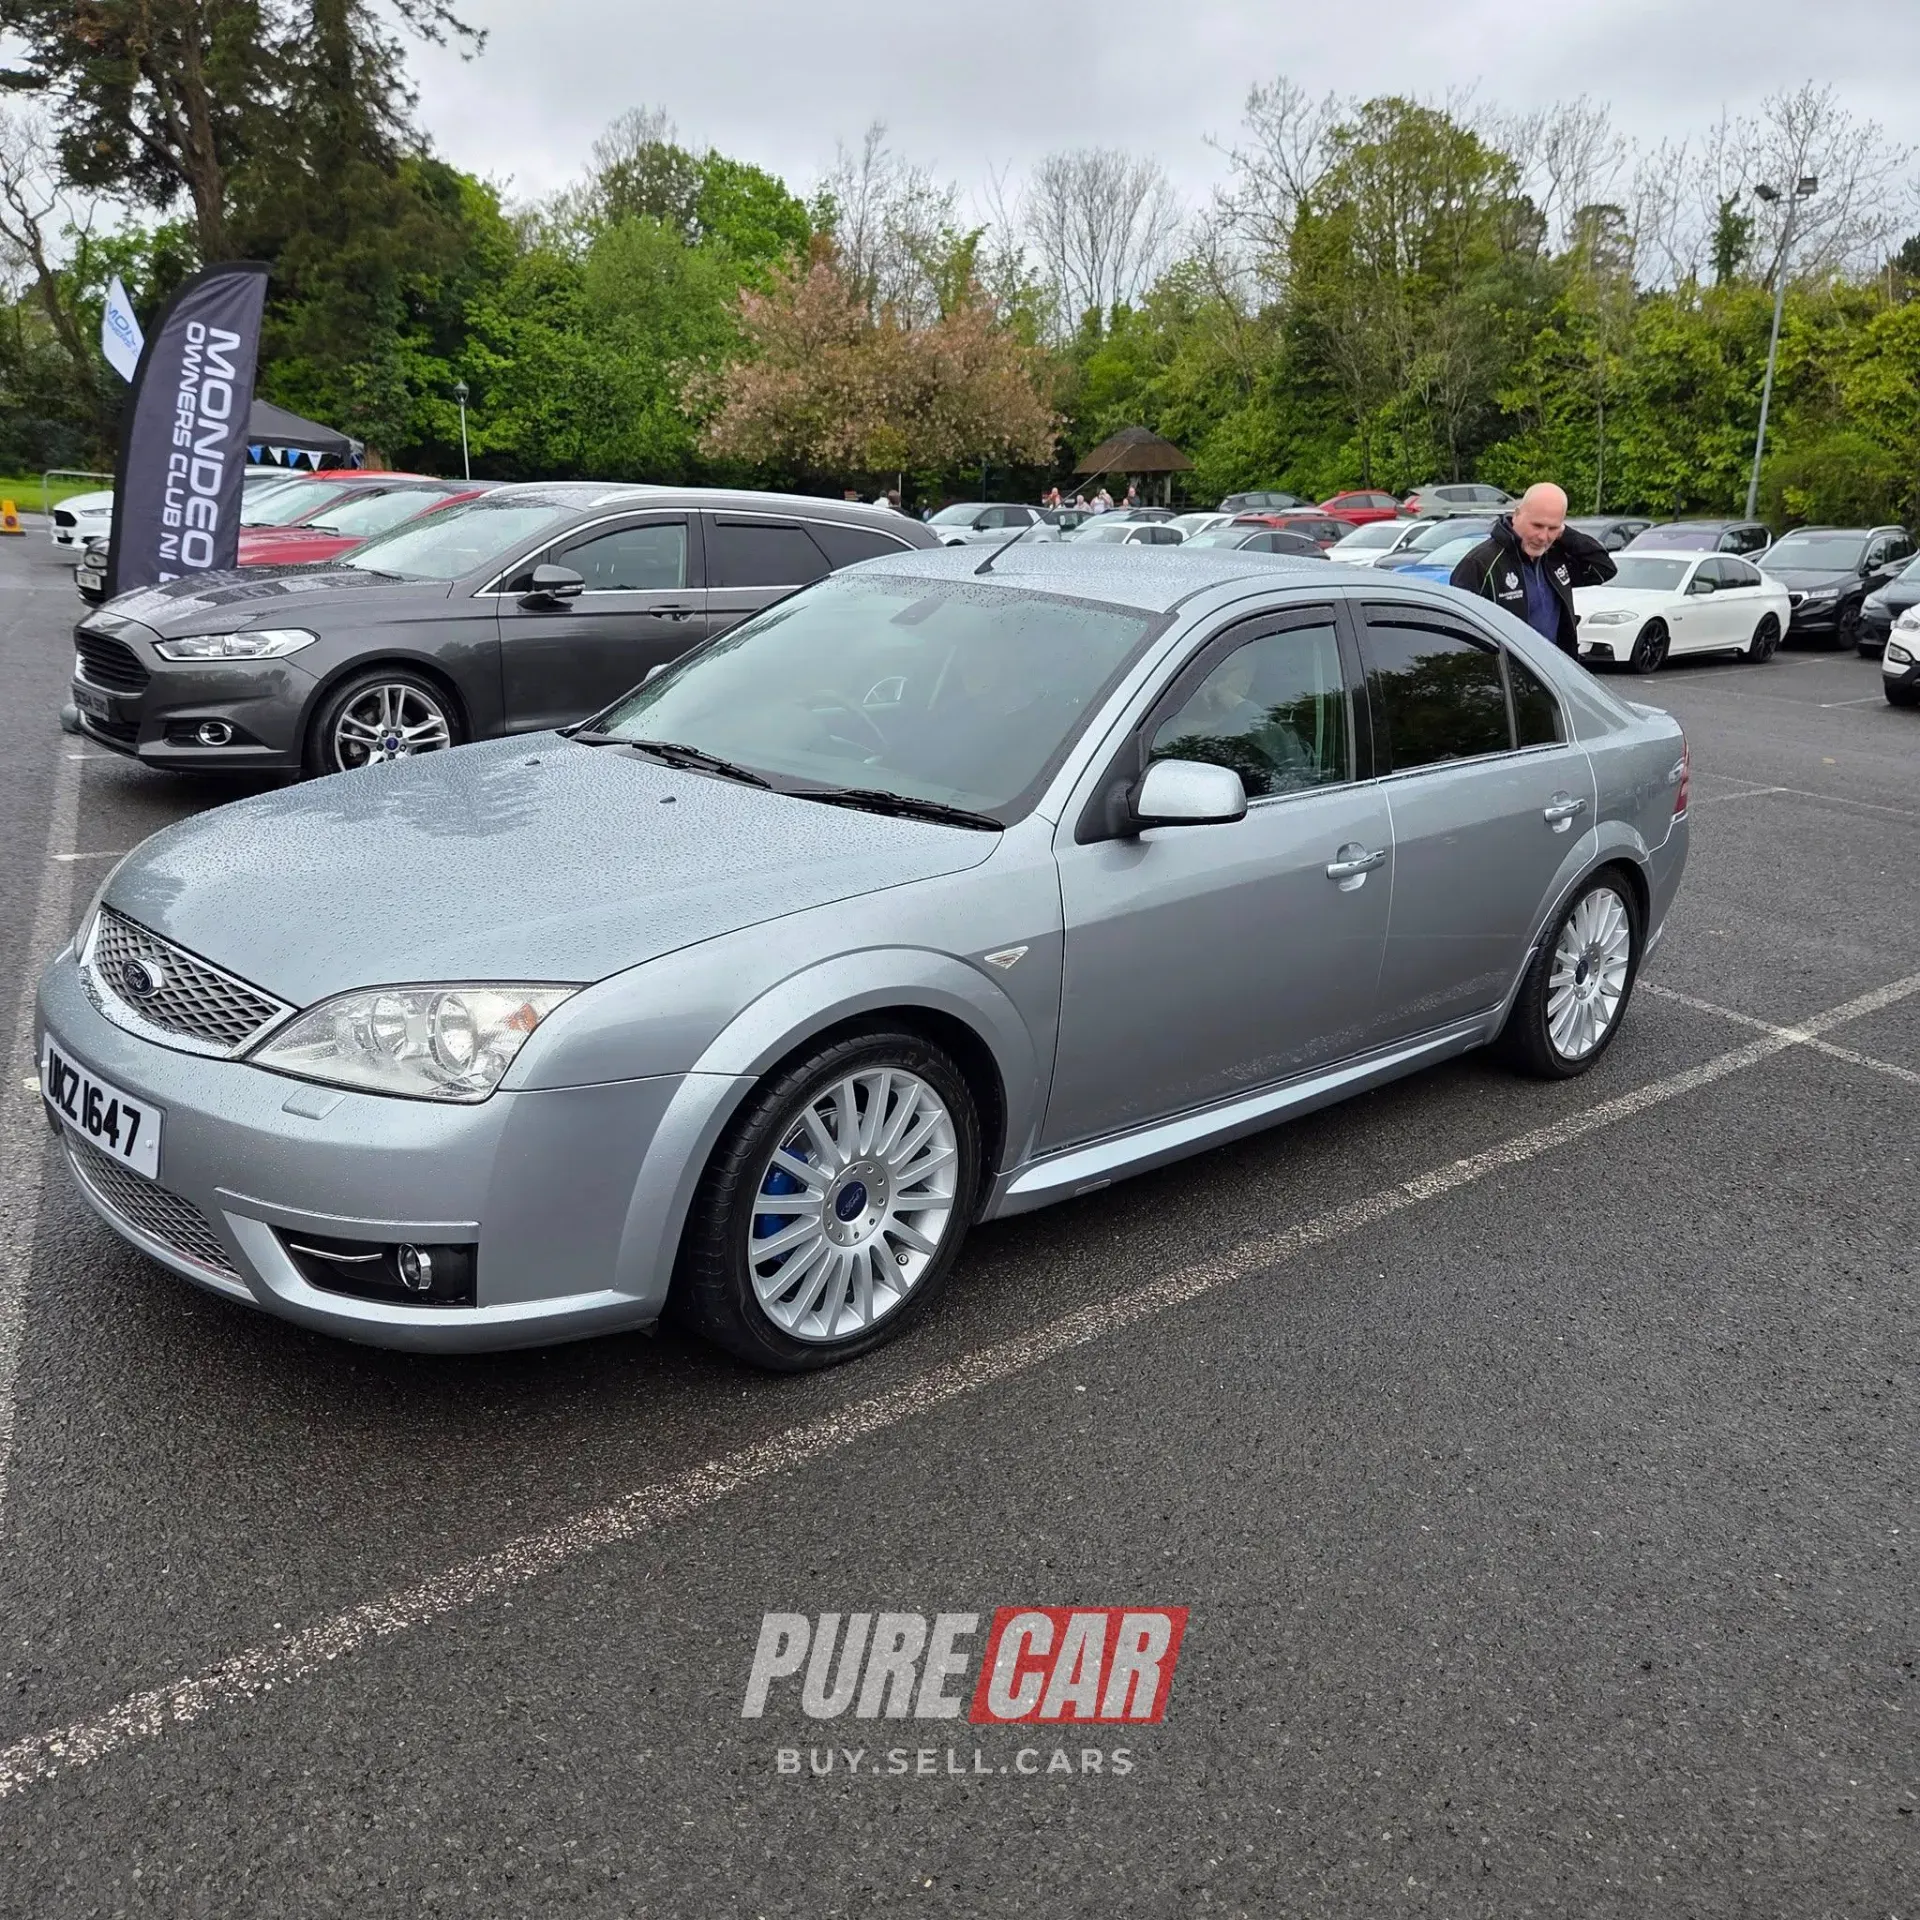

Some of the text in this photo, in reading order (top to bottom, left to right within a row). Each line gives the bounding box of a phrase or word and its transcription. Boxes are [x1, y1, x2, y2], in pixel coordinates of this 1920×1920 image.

[172, 321, 206, 448] OWNERS
[162, 452, 188, 528] CLUB
[181, 327, 241, 568] MONDEO
[158, 532, 180, 560] NI
